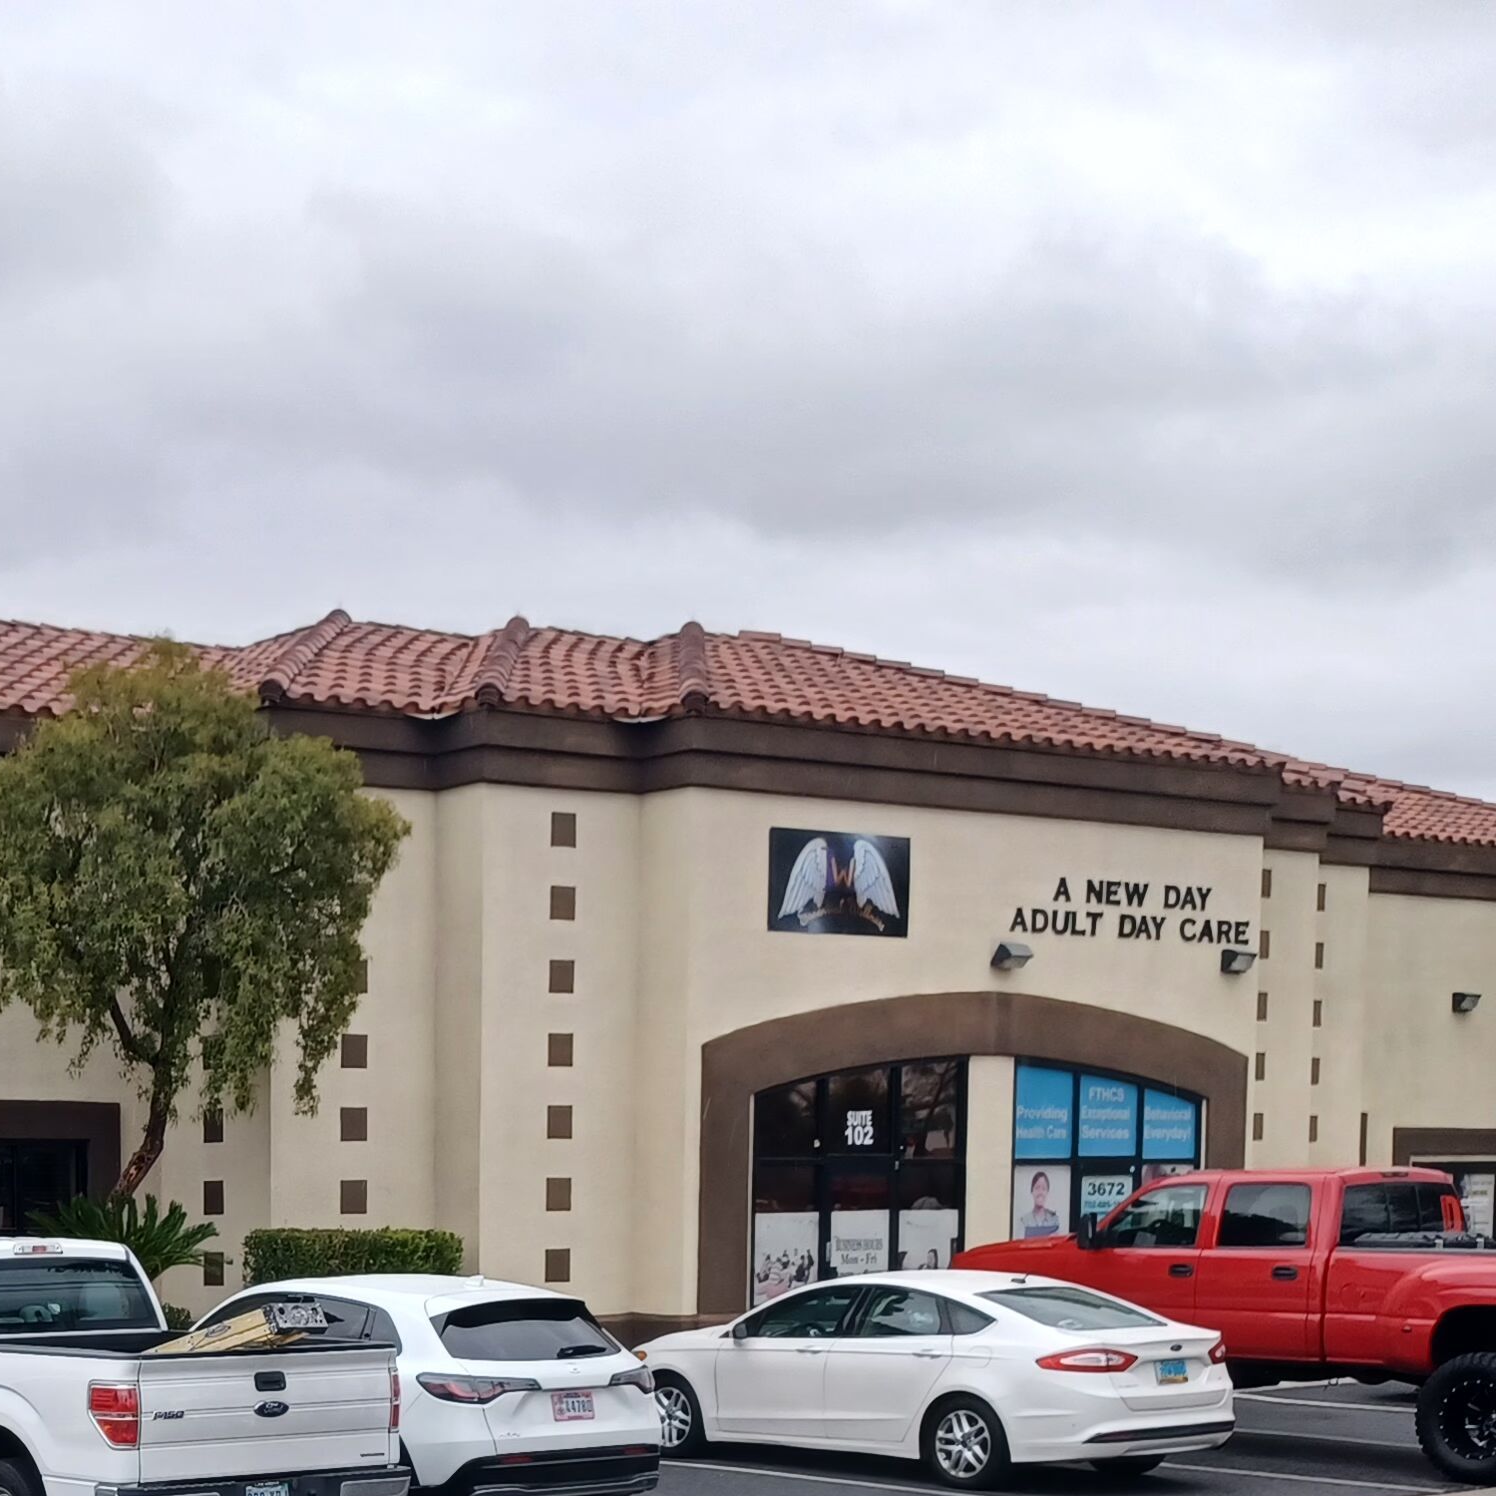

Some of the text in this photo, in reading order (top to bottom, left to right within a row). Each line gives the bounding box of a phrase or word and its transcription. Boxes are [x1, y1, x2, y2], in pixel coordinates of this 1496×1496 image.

[1053, 877, 1212, 912] A NEW DAY
[1009, 907, 1250, 945] ADULT DAY CARE
[847, 1110, 873, 1127] SUITE
[1016, 1104, 1068, 1123] Providing
[845, 1126, 874, 1145] 102
[1082, 1123, 1130, 1139] Services
[1087, 1181, 1126, 1197] 3672
[865, 1252, 877, 1265] Fri
